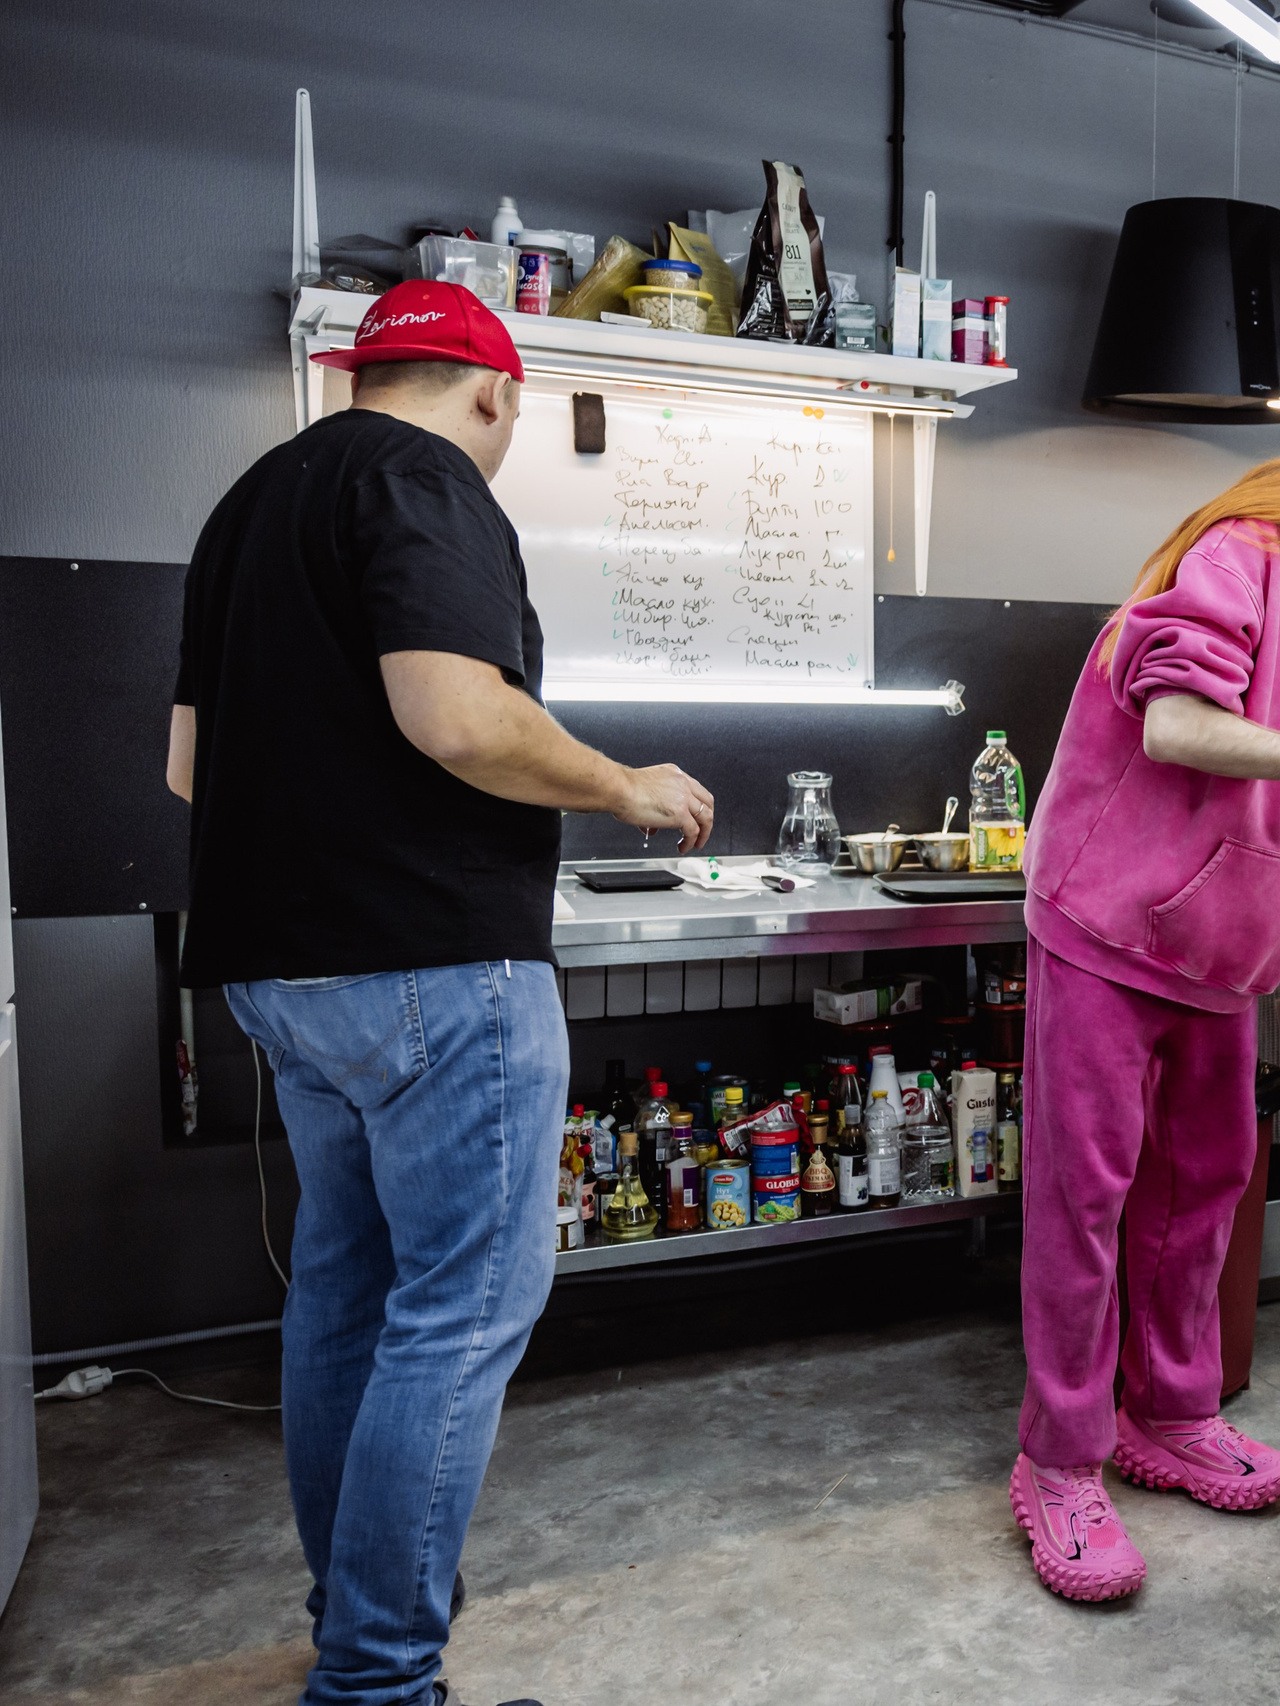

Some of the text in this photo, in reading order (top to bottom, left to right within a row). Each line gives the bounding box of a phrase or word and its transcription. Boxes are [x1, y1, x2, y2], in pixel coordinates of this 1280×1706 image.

[785, 244, 802, 260] 811
[814, 499, 852, 517] 100
[619, 588, 675, 610] Масло
[966, 1097, 995, 1110] Gusto
[809, 1167, 828, 1175] BBQ
[765, 1177, 800, 1190] GLOBUS
[716, 1187, 730, 1195] Нут
